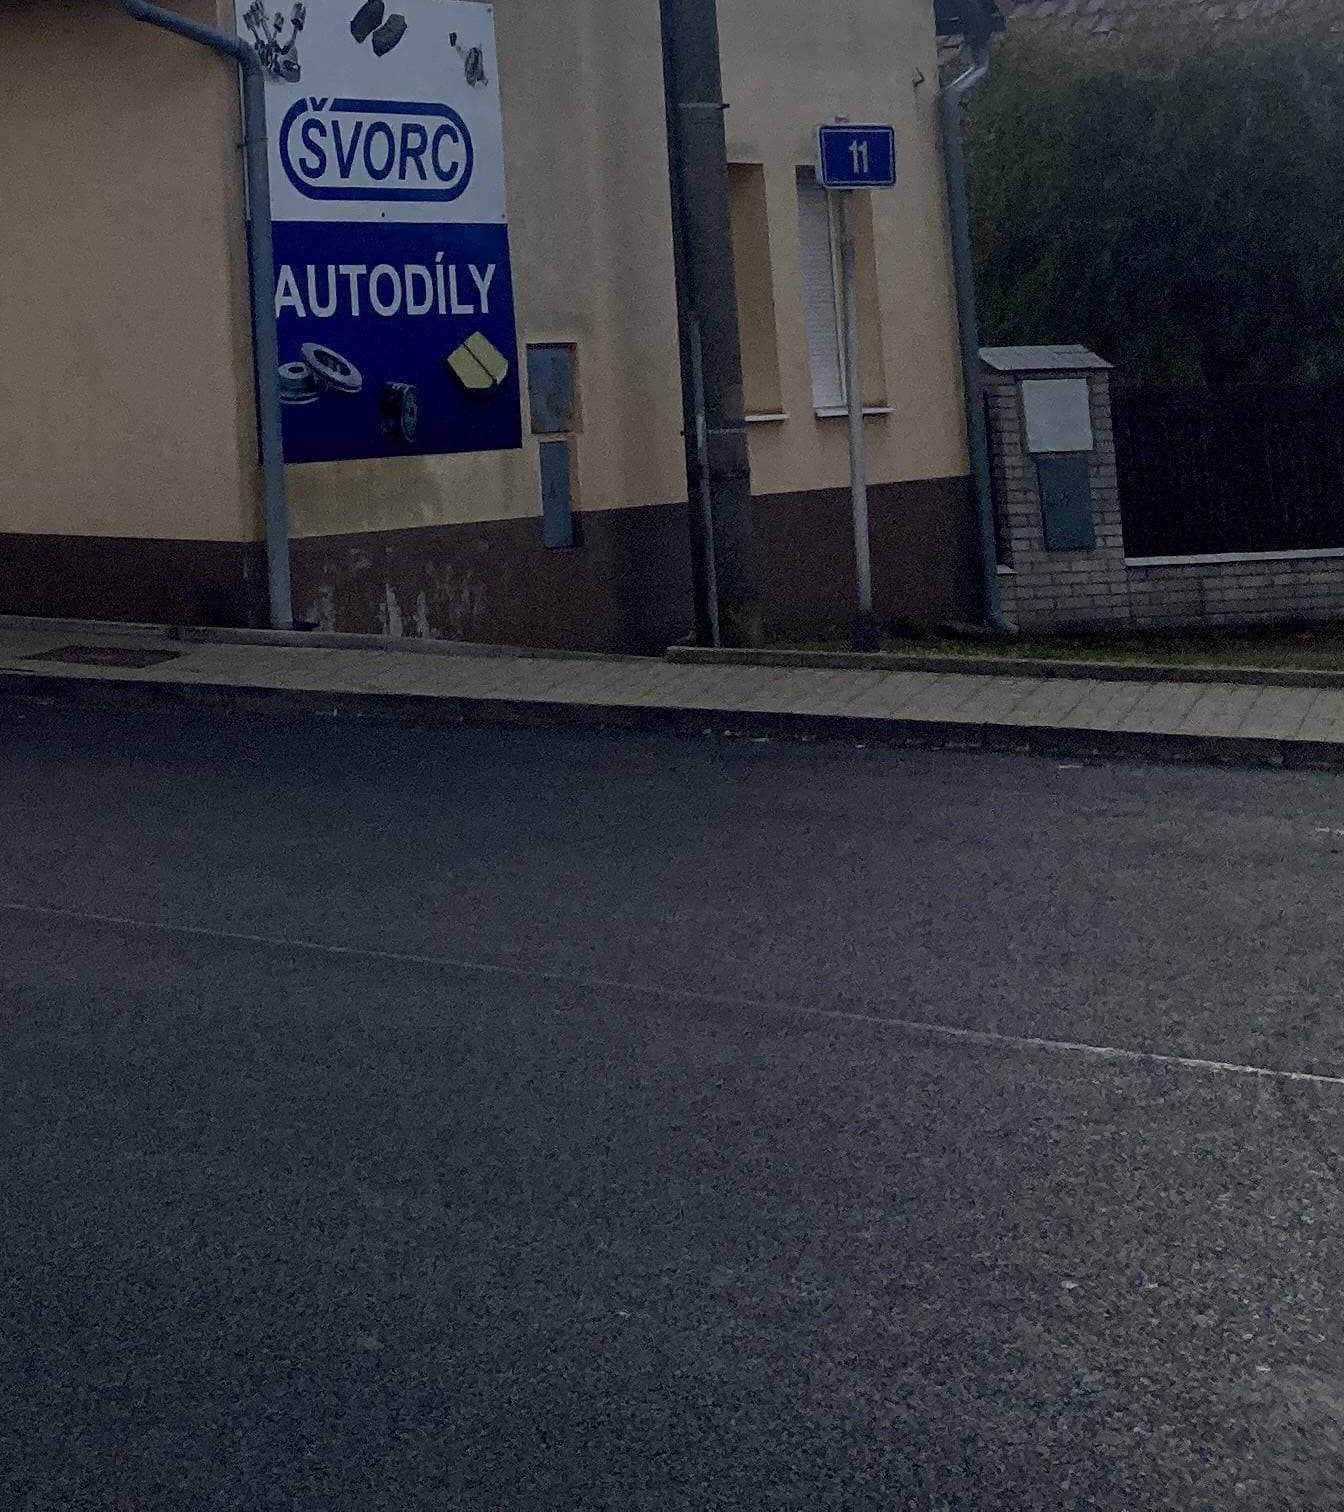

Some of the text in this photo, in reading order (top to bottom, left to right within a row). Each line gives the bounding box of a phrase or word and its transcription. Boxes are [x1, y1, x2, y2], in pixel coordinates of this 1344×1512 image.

[298, 98, 460, 182] ŠVORC
[849, 140, 868, 173] 11
[276, 252, 495, 317] AUTODÍLY
